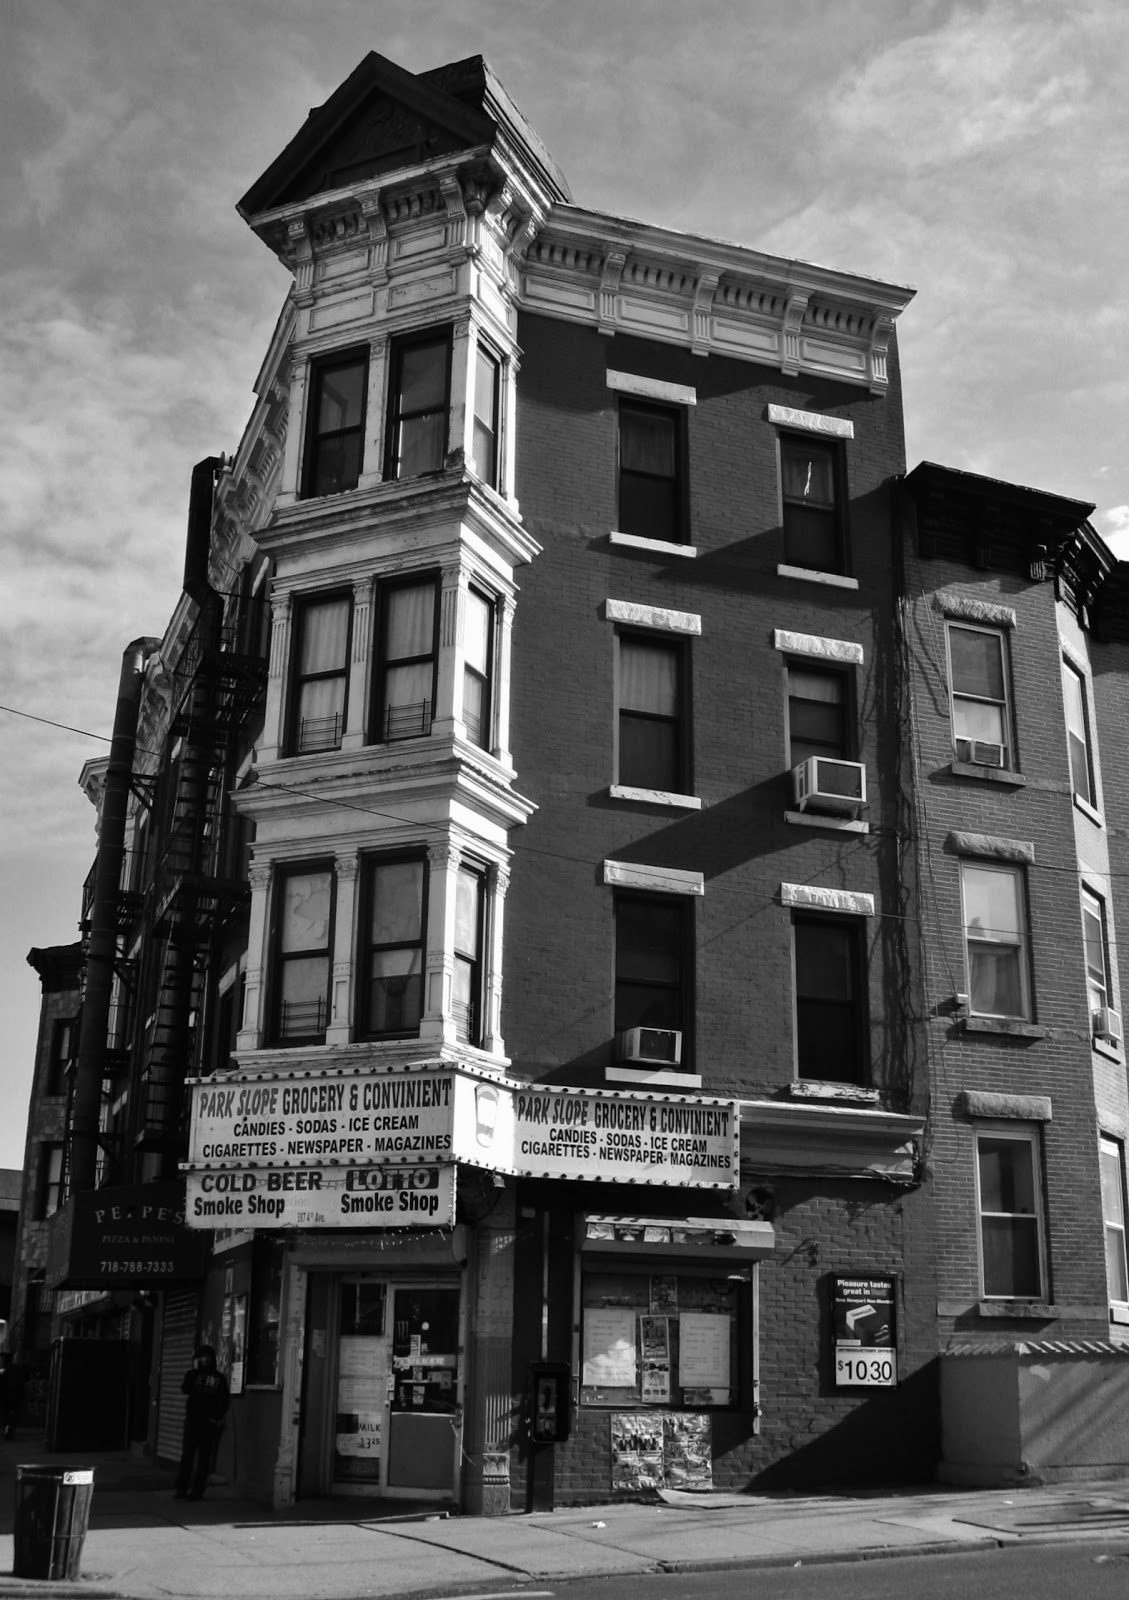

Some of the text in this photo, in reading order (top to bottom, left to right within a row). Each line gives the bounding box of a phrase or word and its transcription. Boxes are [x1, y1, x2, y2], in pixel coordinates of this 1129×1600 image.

[200, 1078, 452, 1118] PARK SLOPE GROCERY & CONVINIENT
[233, 1121, 285, 1137] CANDIES
[296, 1118, 337, 1134] SODAS
[349, 1116, 370, 1132] ICE
[373, 1115, 419, 1131] CREAM
[517, 1095, 730, 1137] PARK SLOPE GROCERY & CONVINIENT
[202, 1141, 277, 1158] CIGARETTES
[287, 1138, 363, 1155] NEWSPAPER
[375, 1134, 452, 1152] MAGAZINES
[549, 1128, 597, 1145] CANDIES
[606, 1134, 642, 1148] SODAS
[650, 1136, 668, 1150] ICE
[671, 1138, 707, 1153] CREAM
[521, 1140, 590, 1159] CIGARETTES
[670, 1151, 731, 1169] MAGAZINES
[201, 1171, 323, 1193] COLD BEER
[352, 1168, 431, 1190] LOTTO
[194, 1196, 243, 1216] Smoke
[248, 1194, 285, 1218] Shop
[340, 1190, 439, 1216] Smoke Shop
[102, 1235, 130, 1243] PIZZA
[100, 1261, 175, 1273] 718-788-7333
[837, 1279, 892, 1289] Pleasure tastes
[842, 1288, 862, 1296] great
[838, 1360, 892, 1382] $10.30
[358, 1423, 381, 1432] MILK
